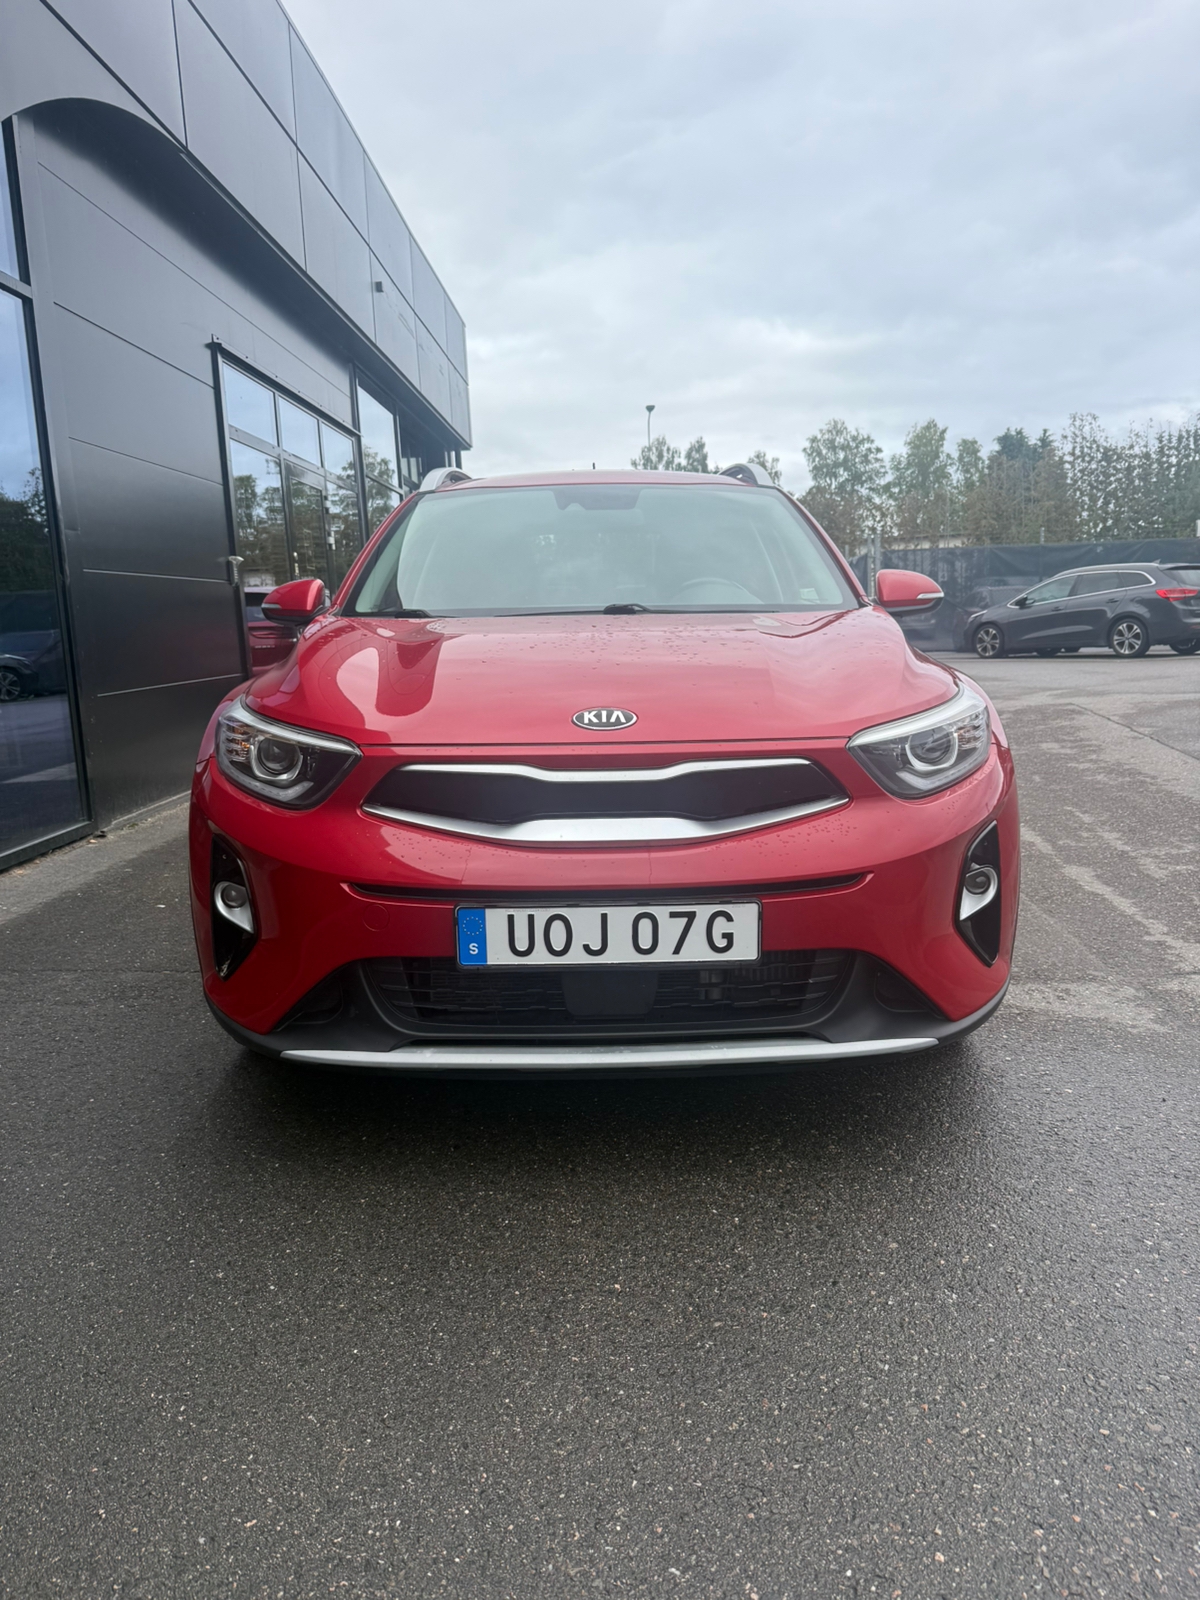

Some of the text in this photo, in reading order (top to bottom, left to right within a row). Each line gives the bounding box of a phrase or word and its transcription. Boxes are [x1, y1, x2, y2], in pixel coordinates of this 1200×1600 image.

[583, 710, 627, 724] KIA
[507, 909, 735, 957] UOJ 07G
[469, 942, 479, 955] S
